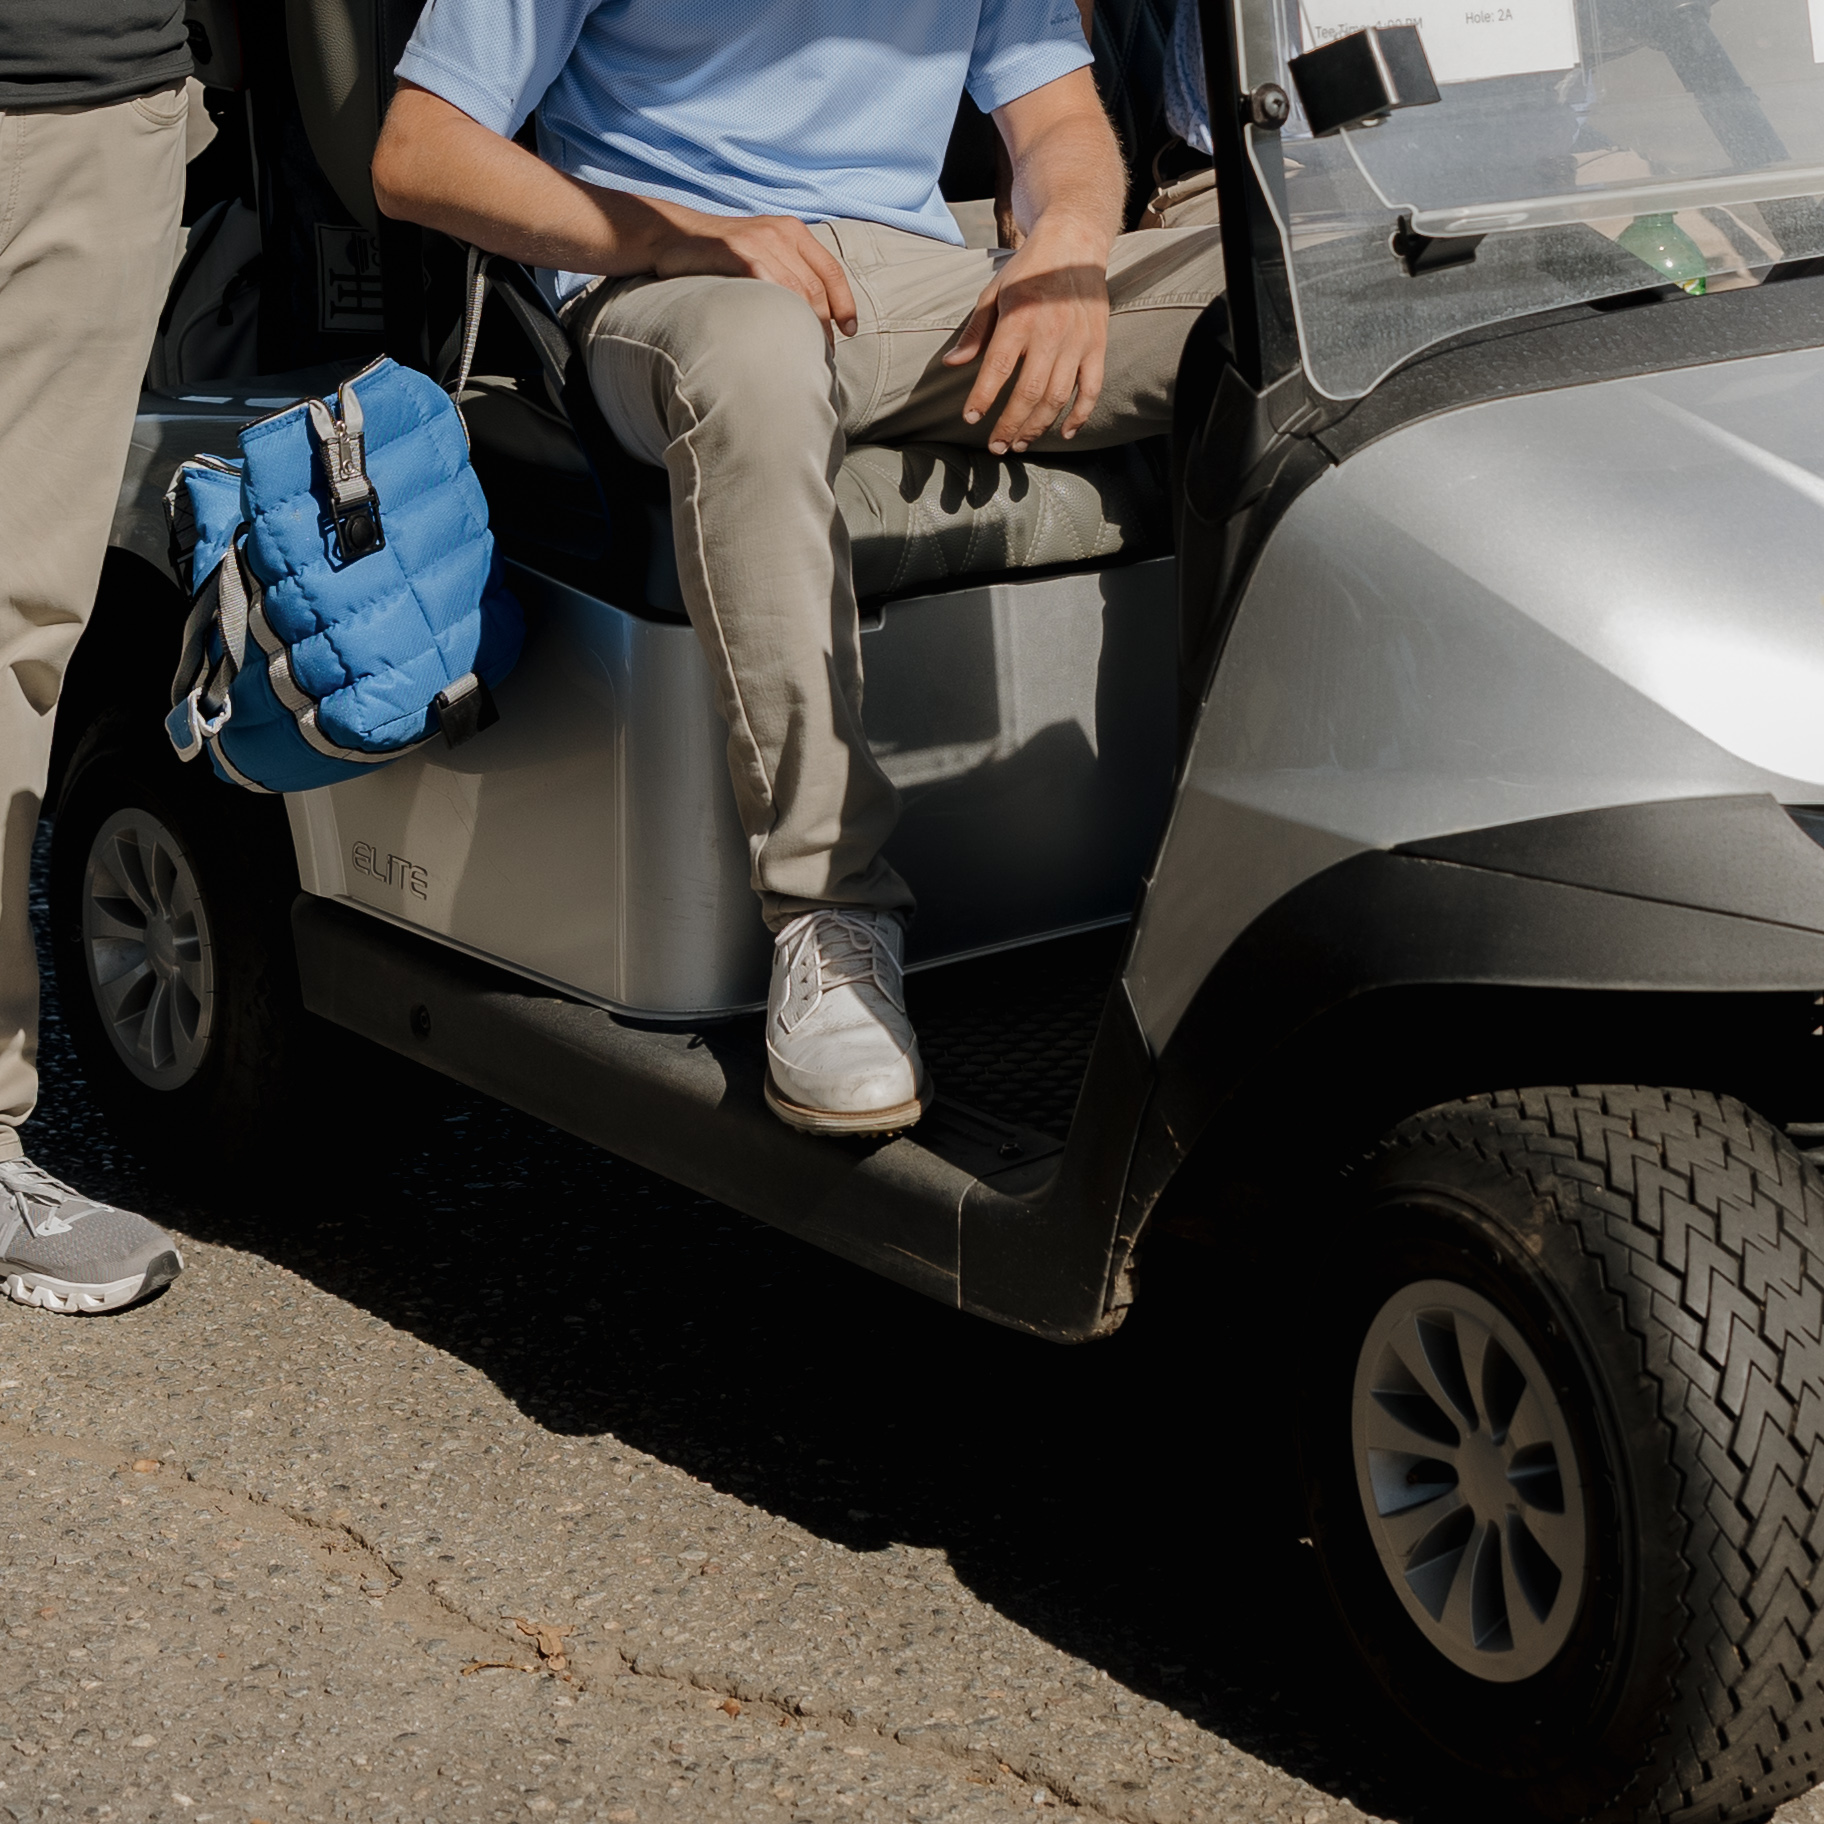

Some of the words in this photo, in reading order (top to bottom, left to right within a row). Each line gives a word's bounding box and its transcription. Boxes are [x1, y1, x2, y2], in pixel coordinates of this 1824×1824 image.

[1465, 11, 1494, 25] Hole:
[1497, 8, 1513, 22] 2A
[352, 840, 428, 901] ELITE
